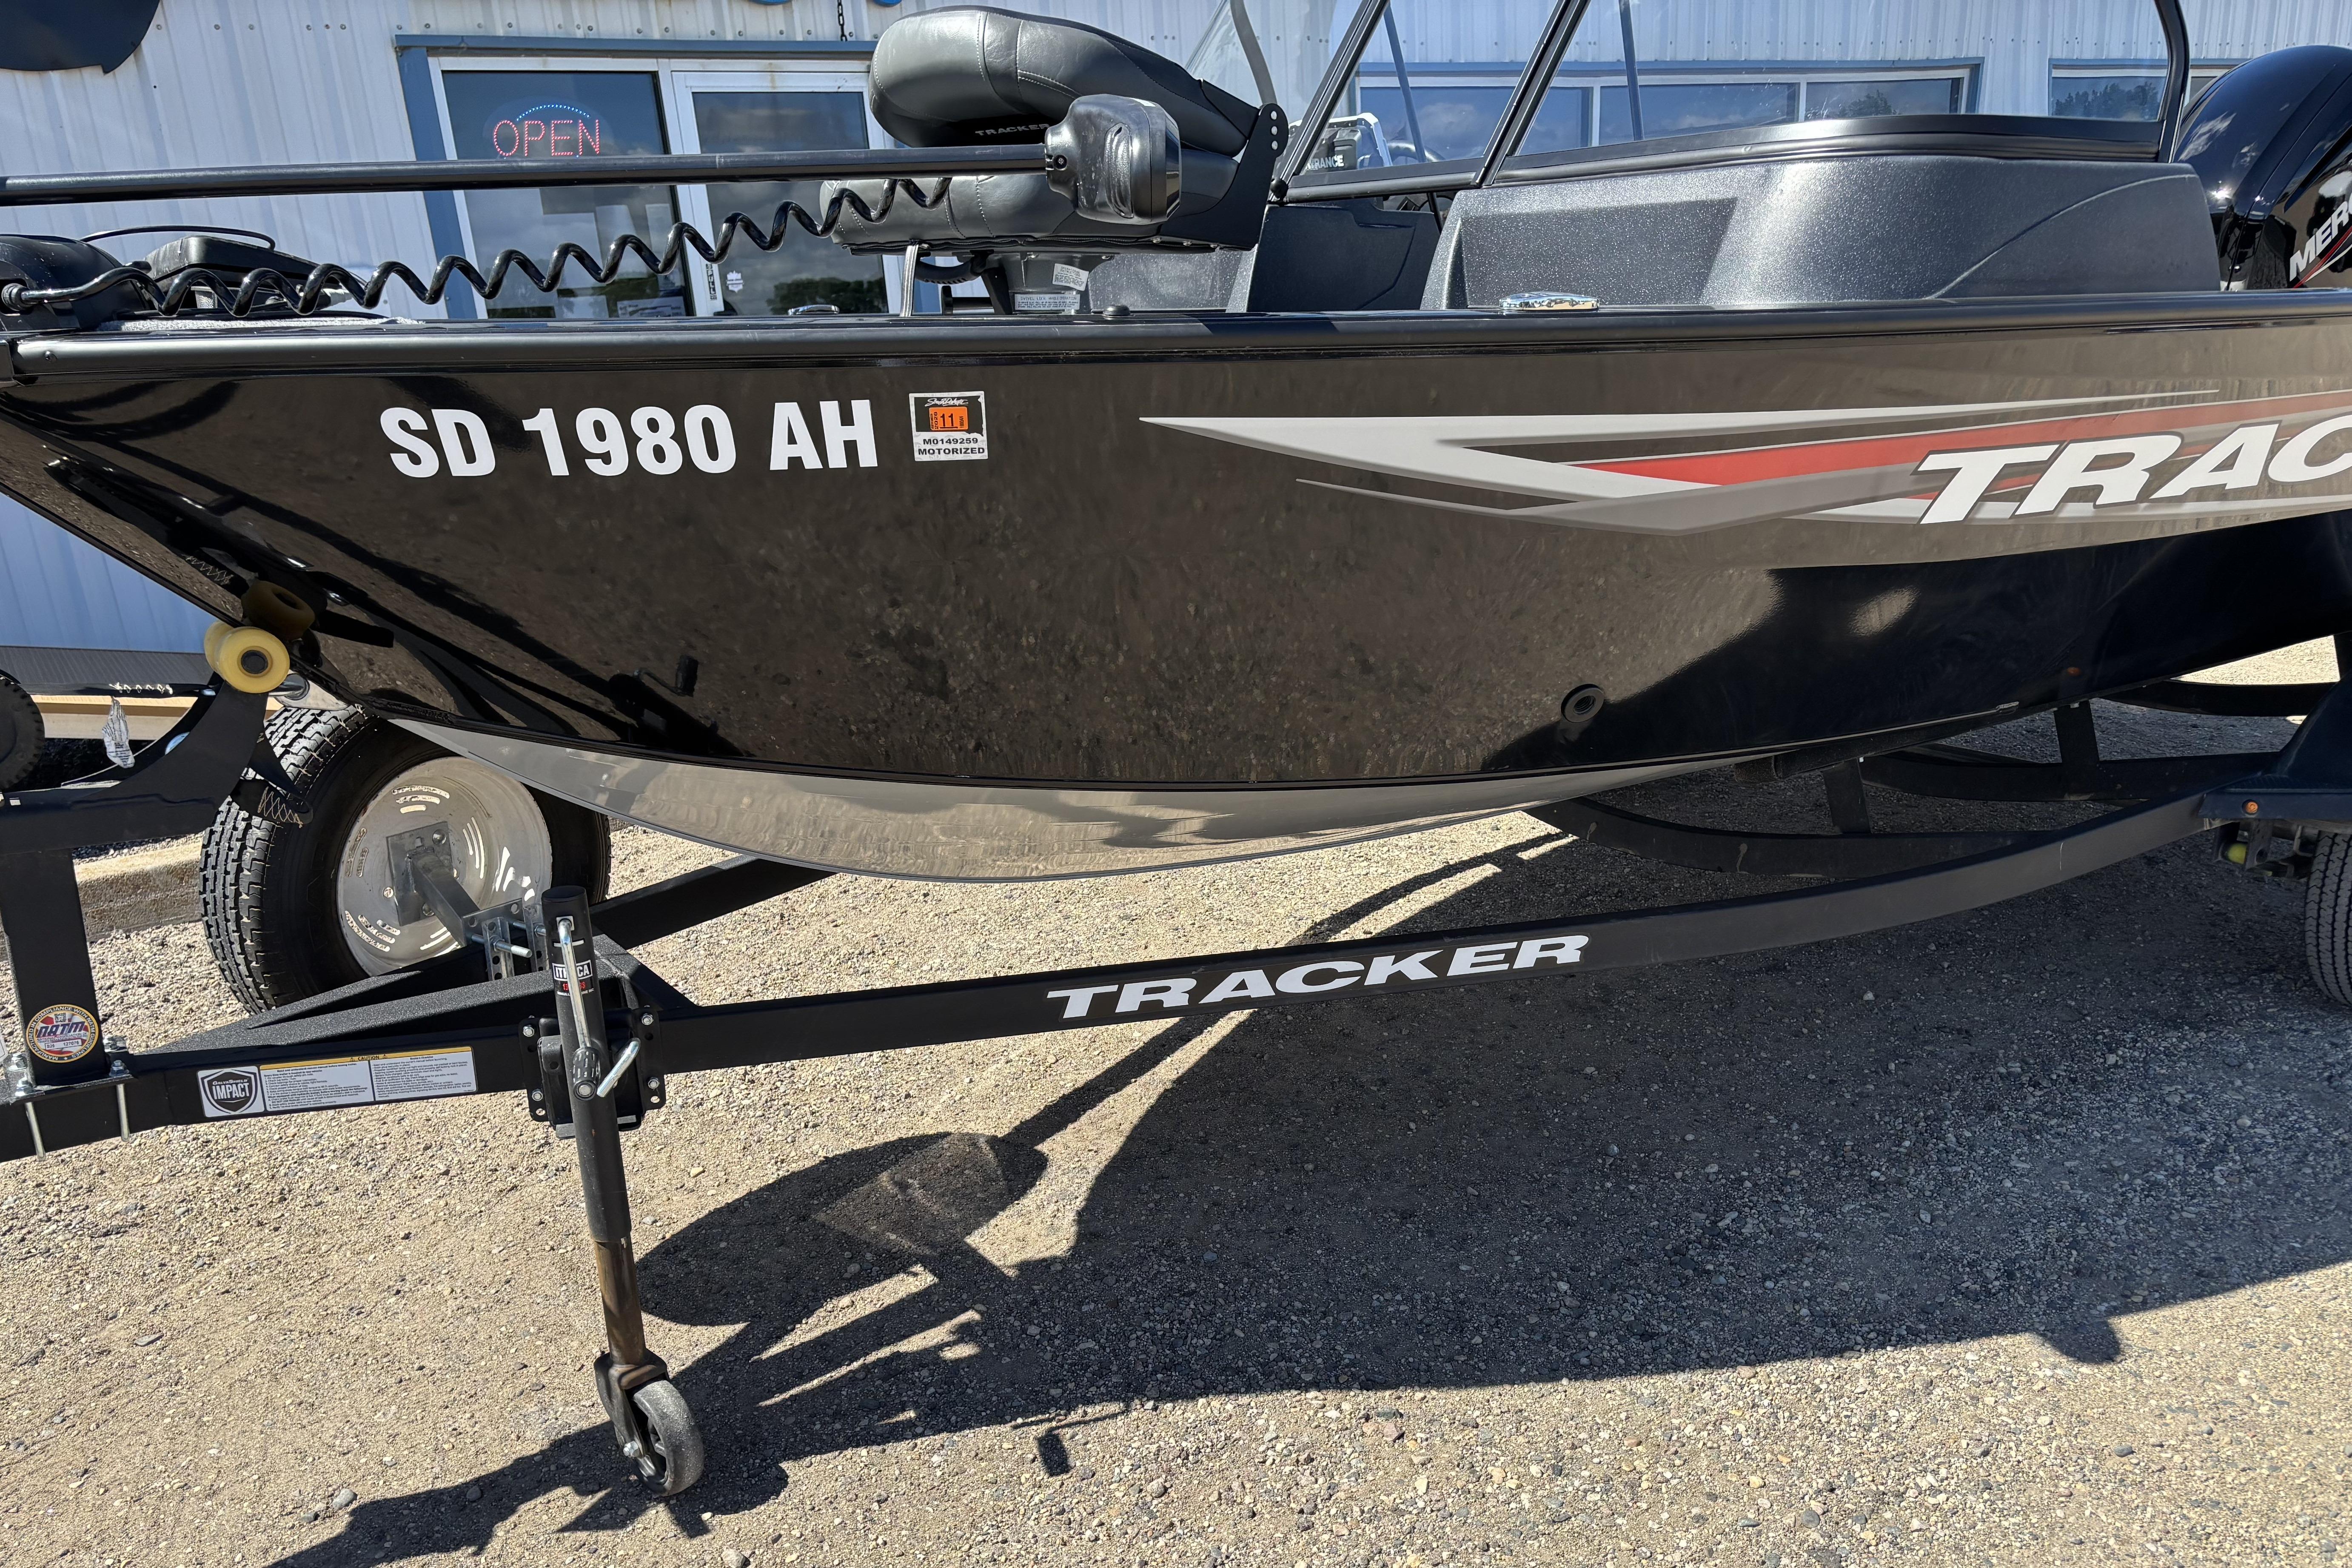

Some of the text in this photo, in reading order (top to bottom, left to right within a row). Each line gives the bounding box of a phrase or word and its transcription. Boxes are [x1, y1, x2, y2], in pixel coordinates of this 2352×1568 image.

[493, 120, 600, 157] OPEN
[975, 124, 1050, 136] TRACKER
[2290, 192, 2352, 282] MER
[940, 413, 954, 427] 11
[381, 400, 878, 477] SD 1980 AH
[1047, 935, 1588, 1018] TRACKER
[35, 1006, 72, 1021] COMPLIANCE
[74, 1008, 87, 1018] WITH
[87, 1018, 95, 1032] NATM
[71, 1032, 95, 1058] GUIDELINES
[212, 1083, 249, 1100] IMPACT
